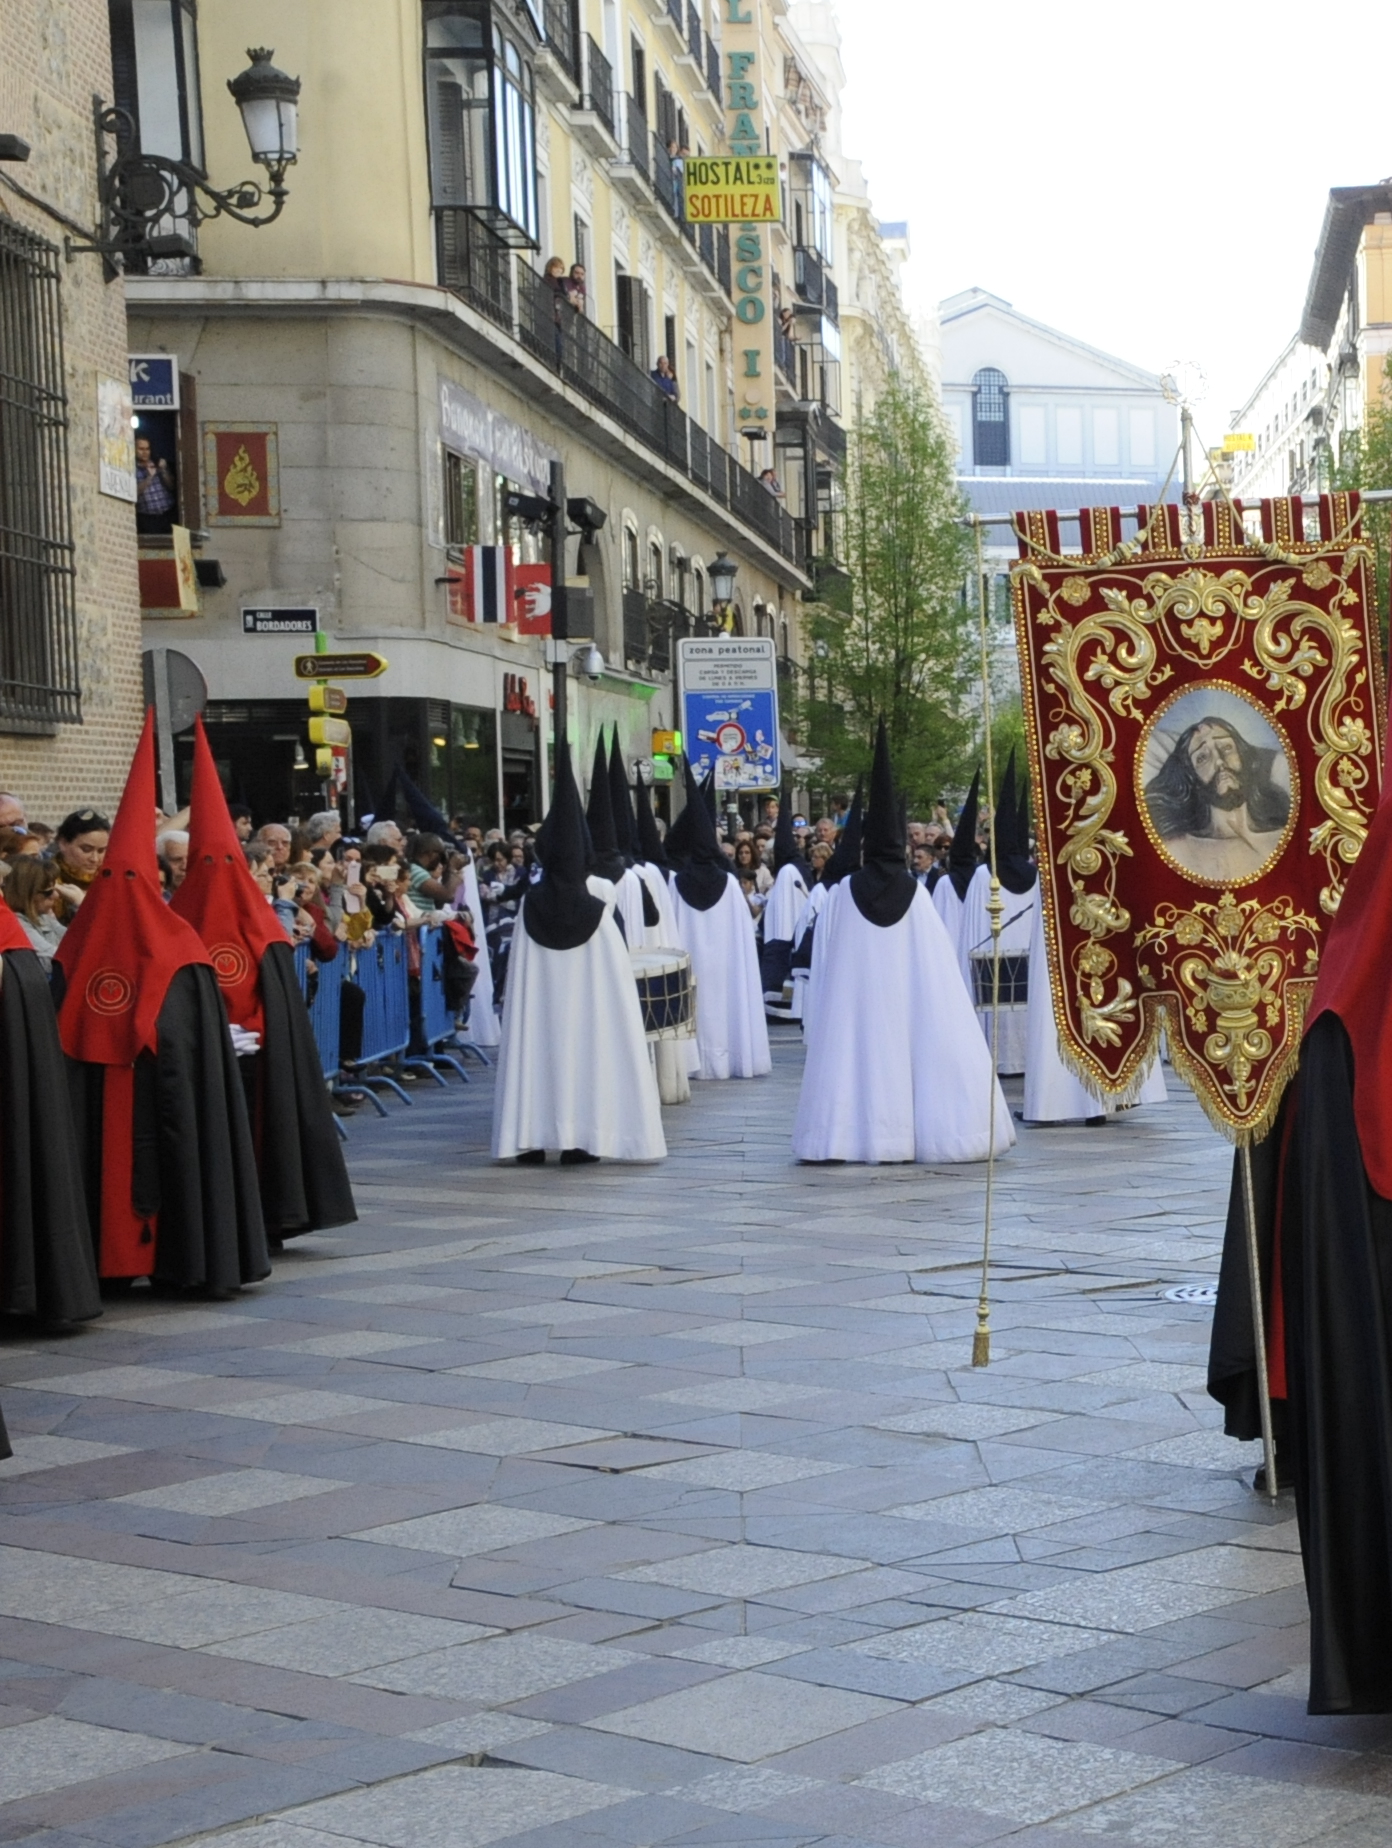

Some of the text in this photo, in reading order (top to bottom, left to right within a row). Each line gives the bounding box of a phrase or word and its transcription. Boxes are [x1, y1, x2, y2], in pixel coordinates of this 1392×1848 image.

[686, 160, 756, 187] HOSTAL
[726, 51, 766, 325] FRASCO
[688, 193, 775, 219] SOTILEZA
[256, 620, 313, 631] BORDADORES
[689, 644, 765, 655] zona peatonal
